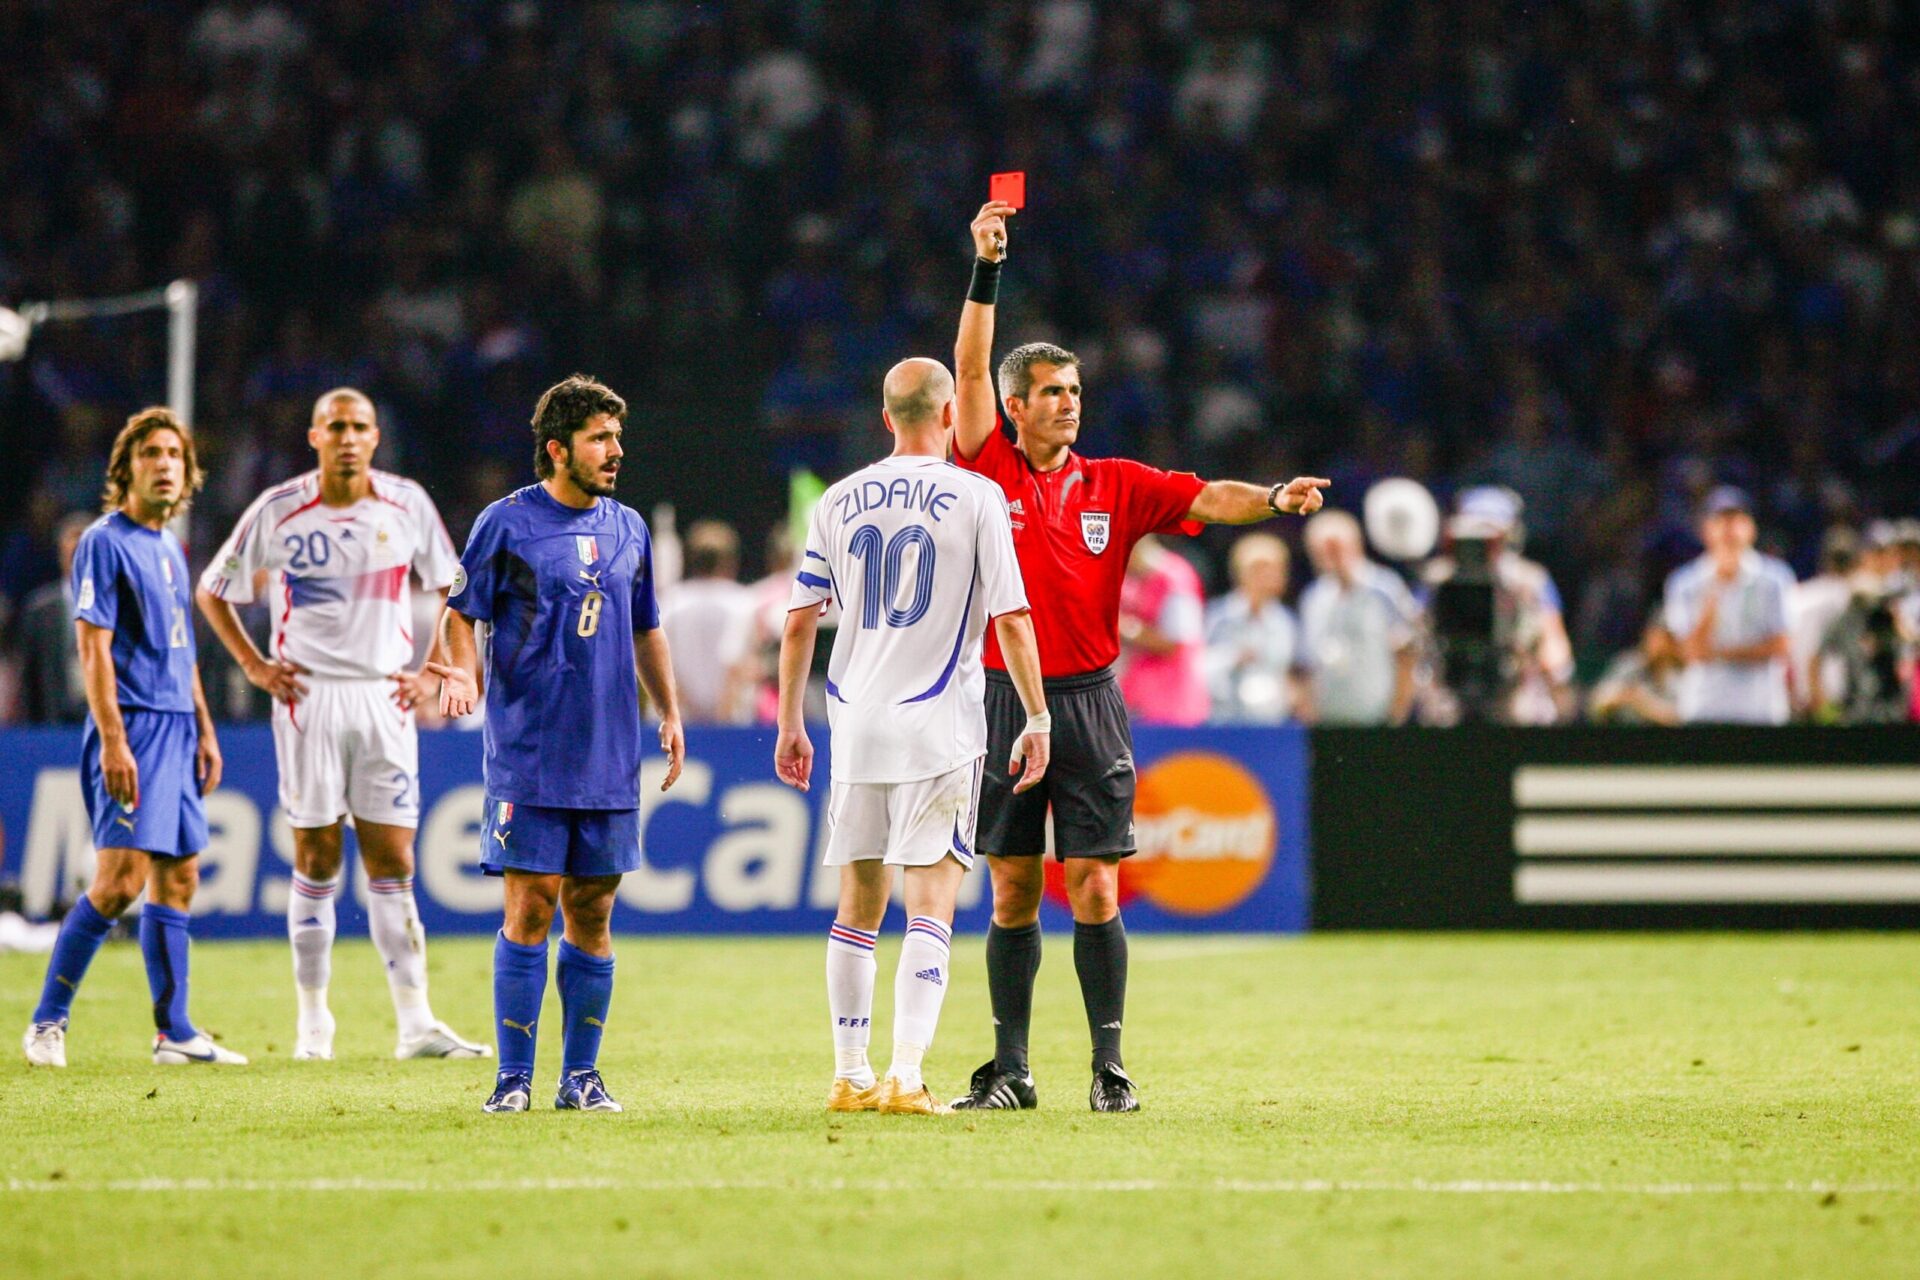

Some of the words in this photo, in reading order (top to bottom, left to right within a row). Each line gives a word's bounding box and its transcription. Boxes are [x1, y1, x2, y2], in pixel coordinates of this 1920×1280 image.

[836, 478, 958, 525] ZIDANE
[284, 531, 329, 569] 20
[848, 524, 936, 629] 10
[577, 590, 602, 637] 8
[915, 970, 942, 986] adidas
